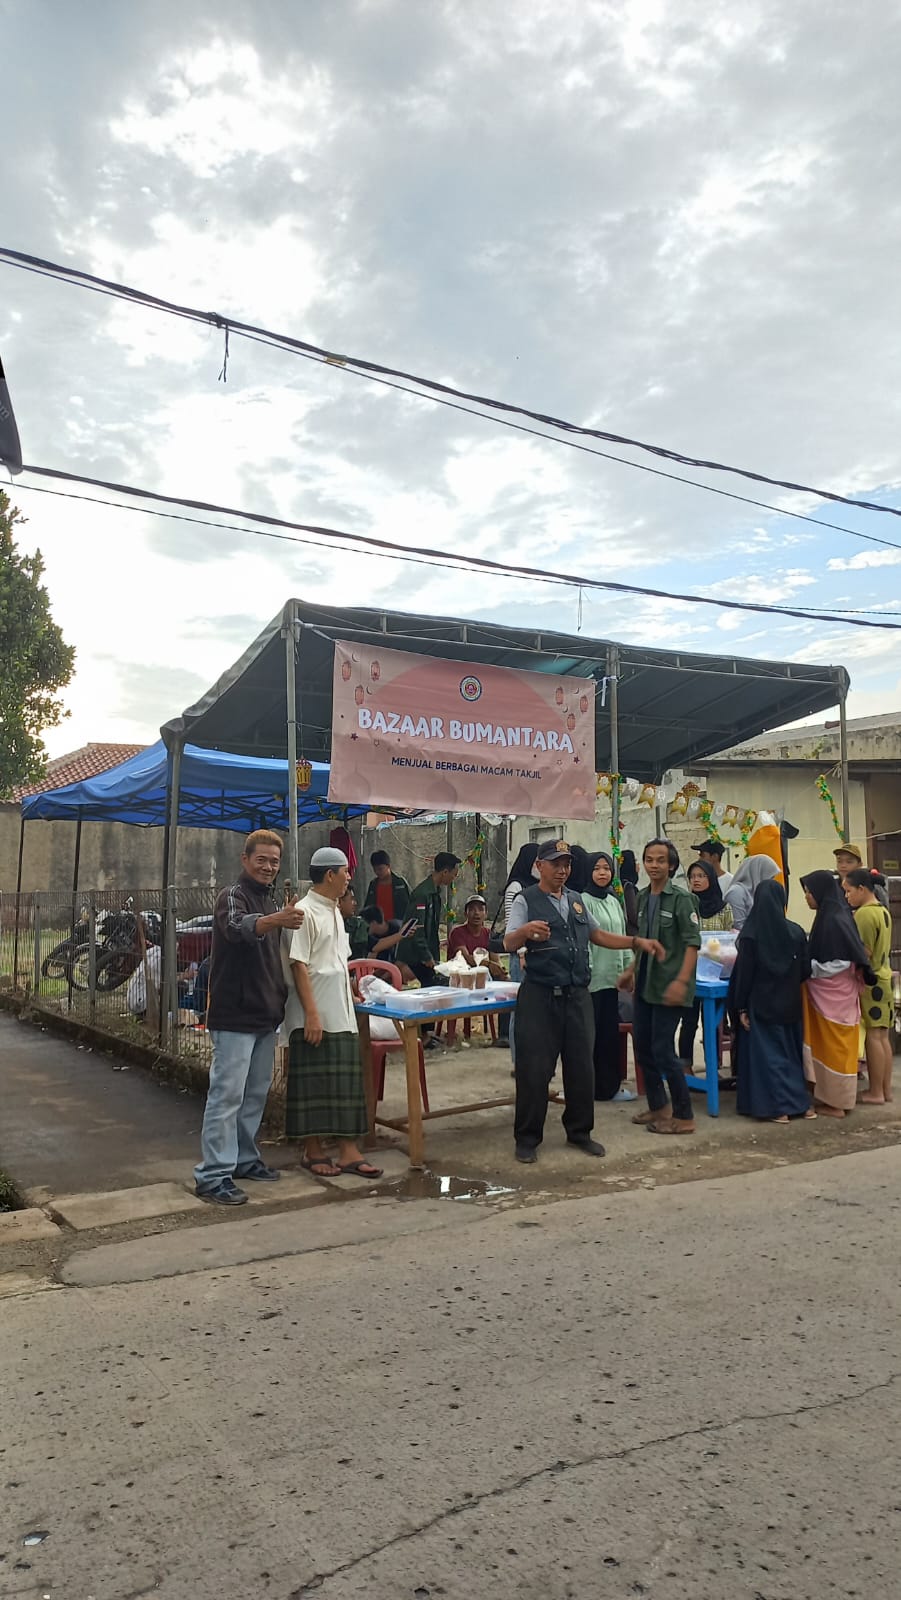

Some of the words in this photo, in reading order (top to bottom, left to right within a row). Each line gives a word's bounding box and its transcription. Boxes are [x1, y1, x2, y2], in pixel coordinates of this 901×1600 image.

[358, 708, 445, 739] BAZAAR
[449, 719, 575, 754] BUMANTARA
[391, 756, 433, 769] MENJUAL
[435, 760, 479, 774] BERBAGAI
[480, 766, 513, 777] MACAM
[515, 769, 542, 780] TAKJIL
